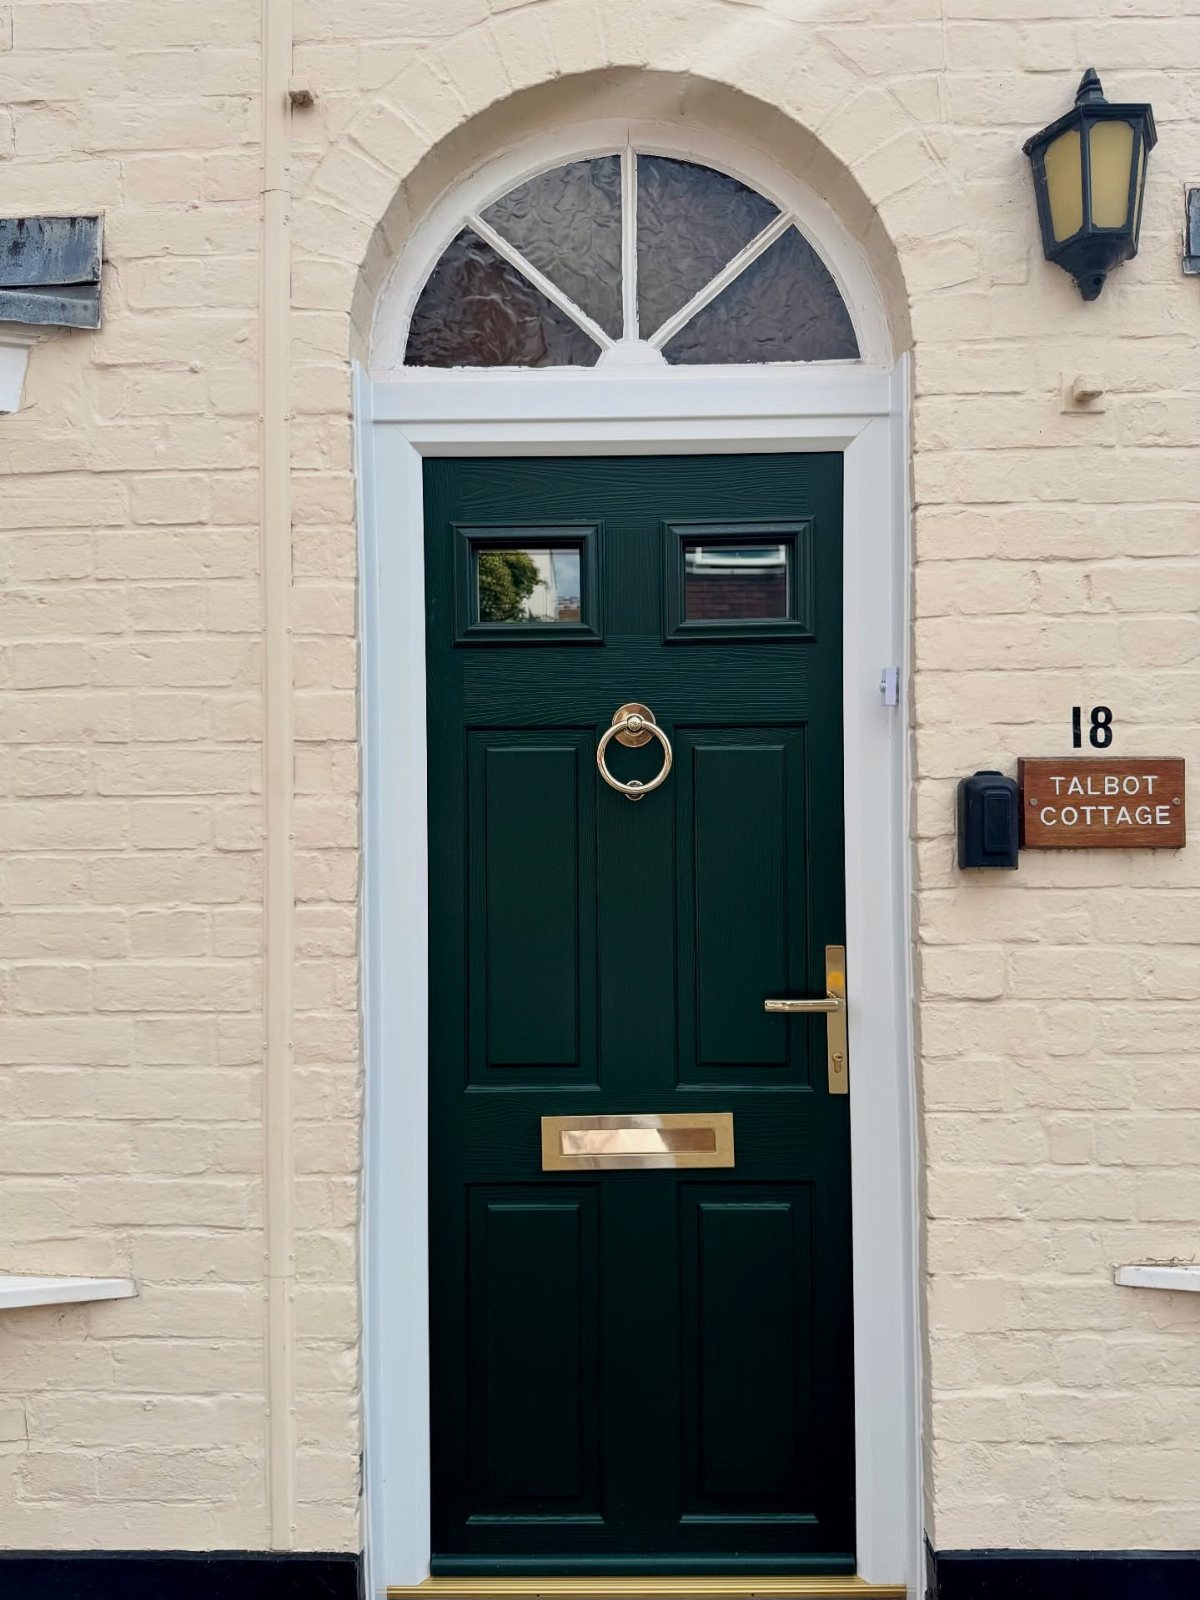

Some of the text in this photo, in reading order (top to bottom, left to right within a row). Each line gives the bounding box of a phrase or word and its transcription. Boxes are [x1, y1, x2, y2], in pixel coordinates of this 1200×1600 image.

[1072, 706, 1113, 748] 18
[1049, 775, 1158, 795] TALBOT
[1040, 805, 1171, 826] COTTAGE
